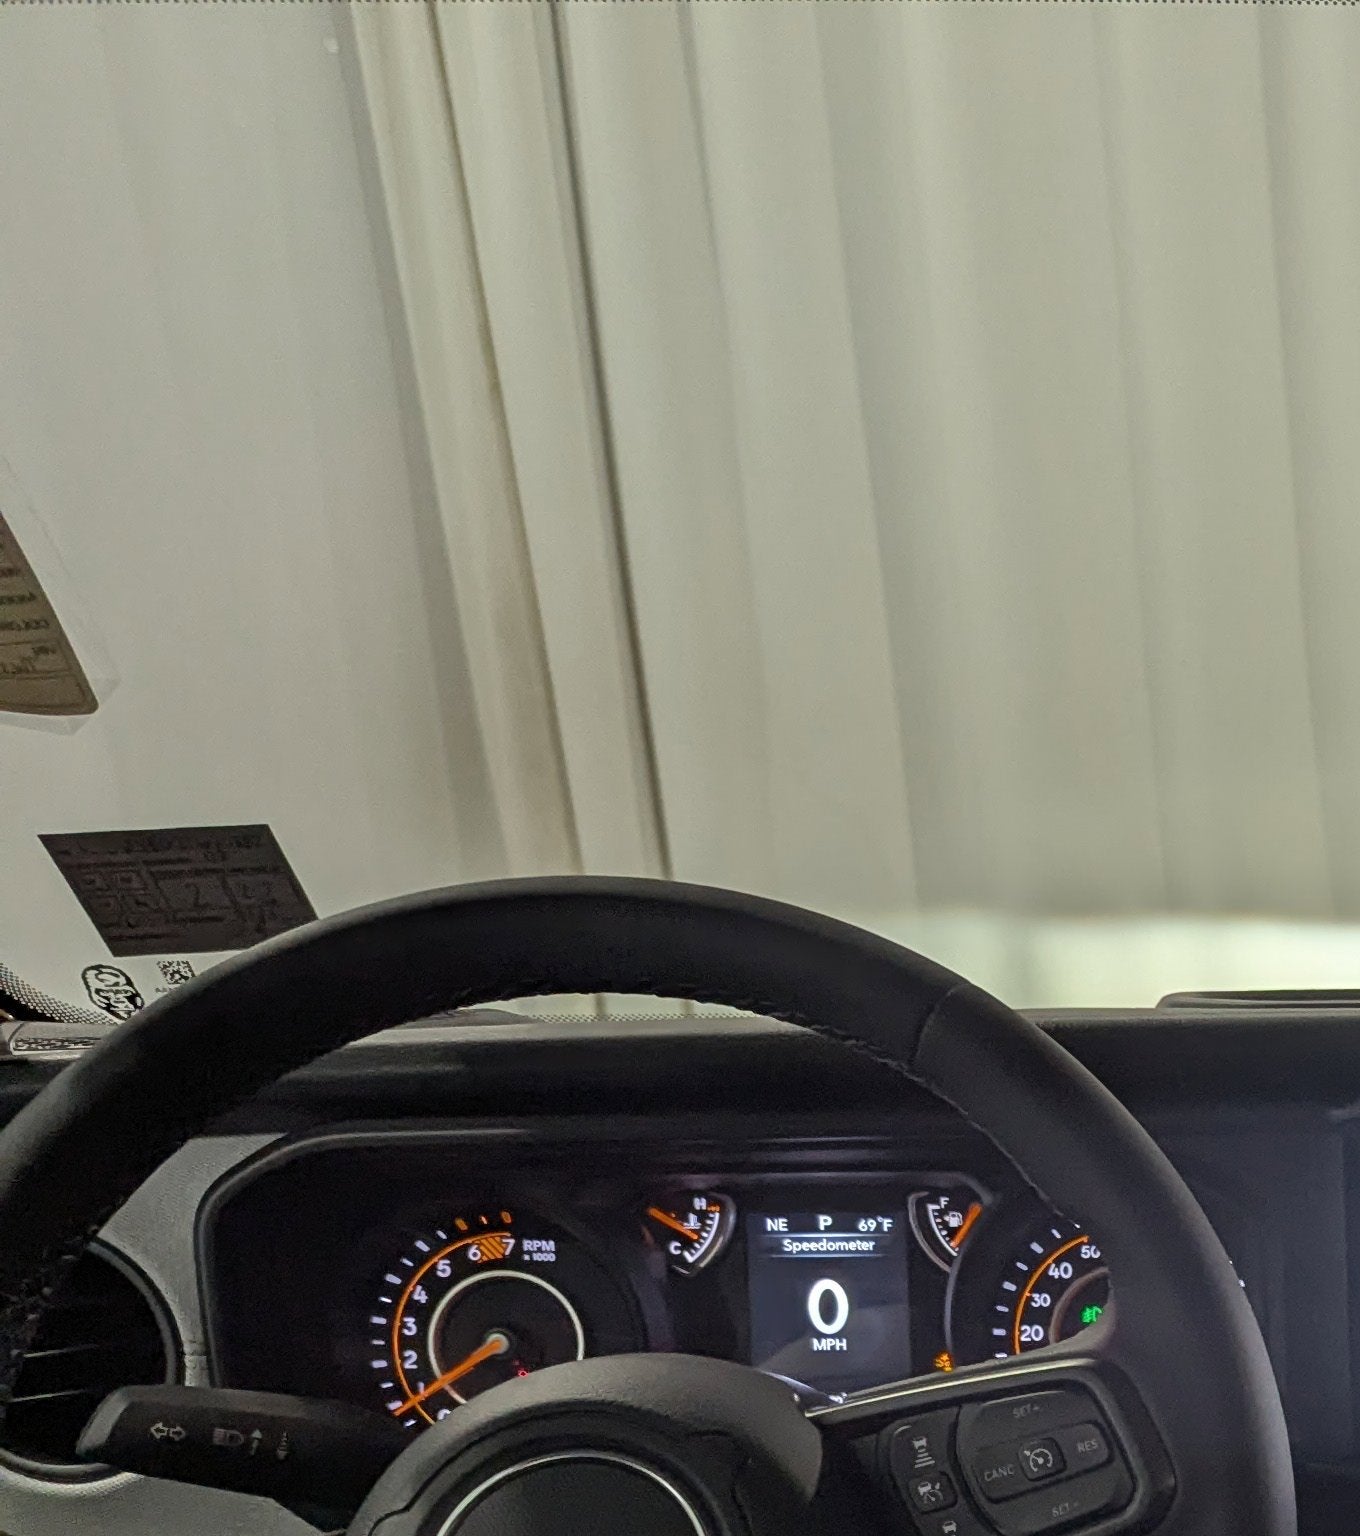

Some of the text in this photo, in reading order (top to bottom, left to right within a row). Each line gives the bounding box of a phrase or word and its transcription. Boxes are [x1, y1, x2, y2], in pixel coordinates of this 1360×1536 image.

[941, 1196, 950, 1210] F
[766, 1217, 789, 1232] NE
[818, 1215, 833, 1231] P
[857, 1215, 894, 1233] 69°F
[467, 1244, 482, 1261] 6
[502, 1238, 515, 1256] 7
[522, 1239, 556, 1252] RPM
[670, 1241, 682, 1255] C
[782, 1238, 876, 1255] Speedometer
[1080, 1244, 1101, 1260] 50
[532, 1252, 556, 1263] 1000
[436, 1259, 452, 1278] 5
[1047, 1261, 1074, 1280] 40
[412, 1284, 429, 1304] 4
[1030, 1292, 1052, 1308] 30
[806, 1277, 850, 1336] 0
[402, 1315, 418, 1336] 3
[1019, 1325, 1044, 1343] 20
[812, 1338, 848, 1352] MPH
[403, 1350, 418, 1369] 2
[1076, 1437, 1100, 1454] RES
[983, 1463, 1016, 1483] CANC
